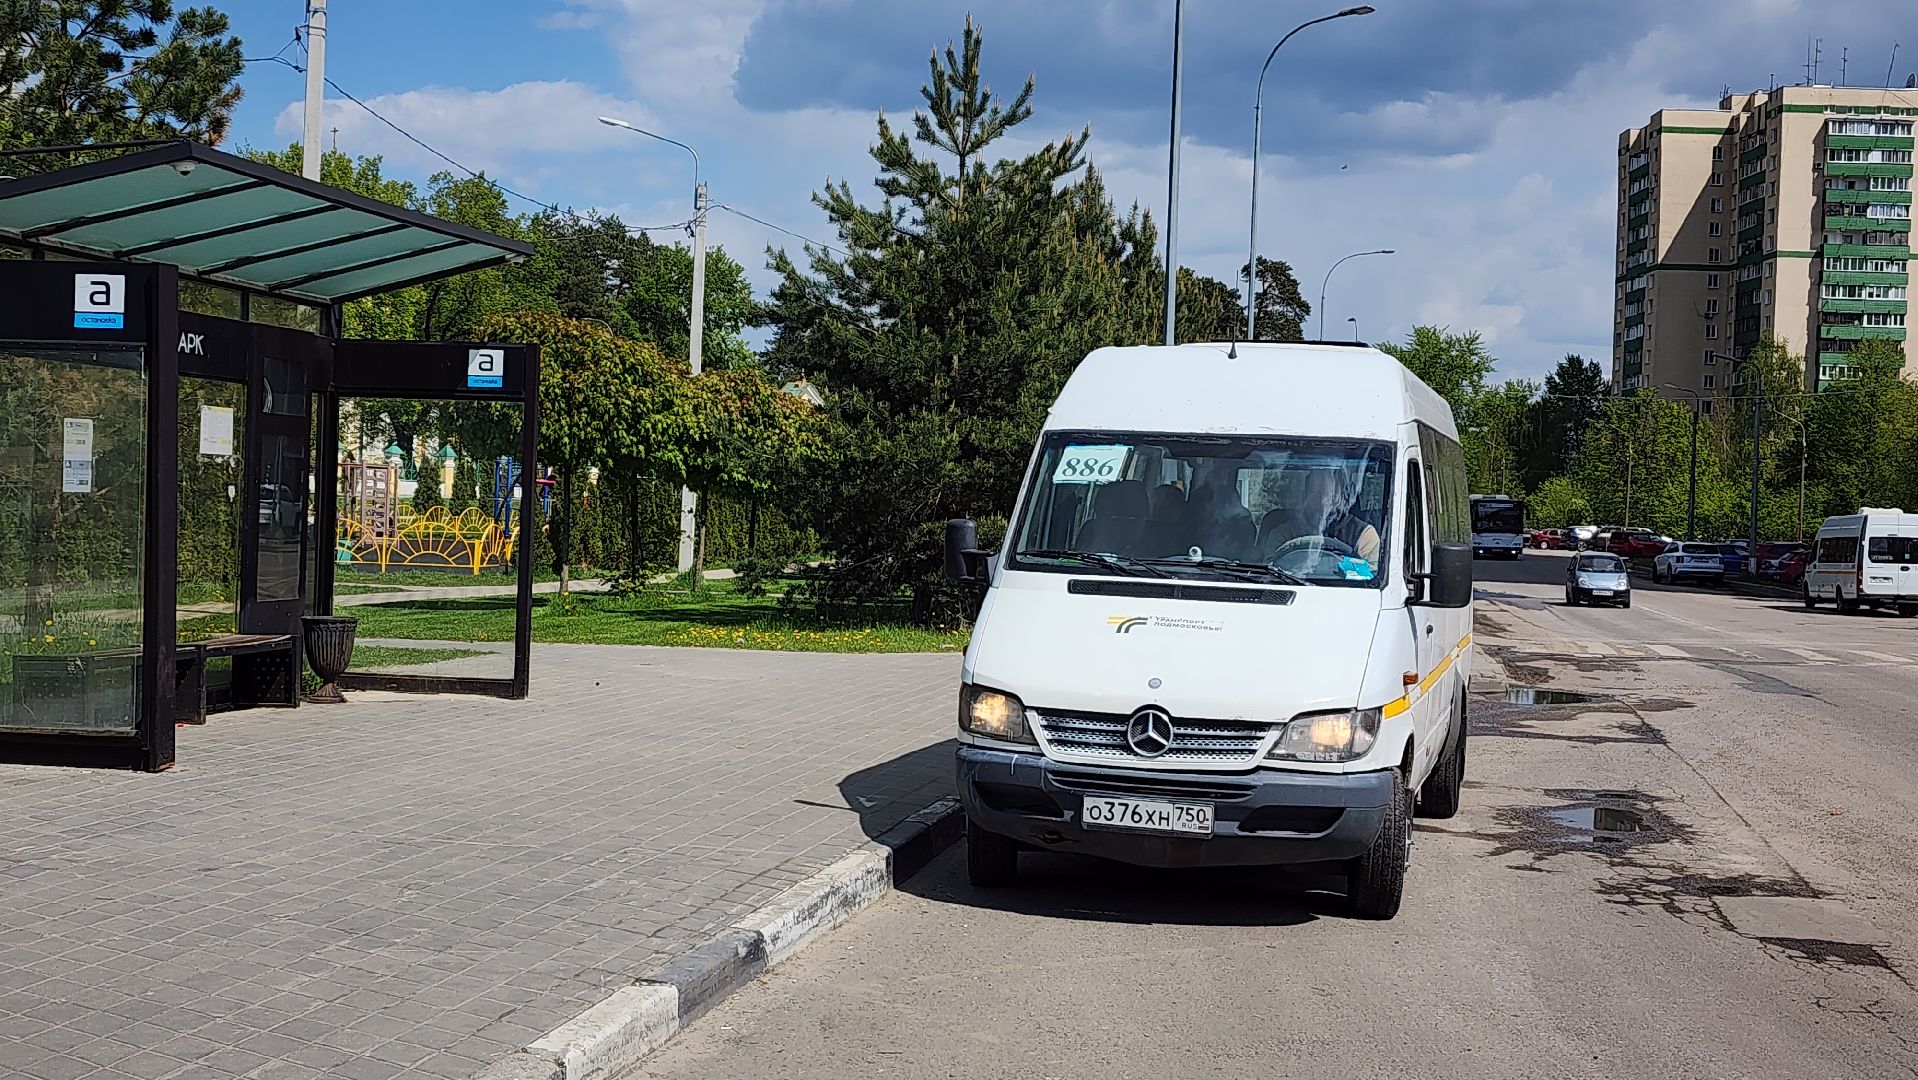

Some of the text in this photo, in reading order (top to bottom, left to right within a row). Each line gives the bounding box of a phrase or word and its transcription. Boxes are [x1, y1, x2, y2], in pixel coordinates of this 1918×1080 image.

[1061, 457, 1119, 477] 886
[1175, 806, 1206, 824] 750
[1181, 822, 1198, 830] RUS
